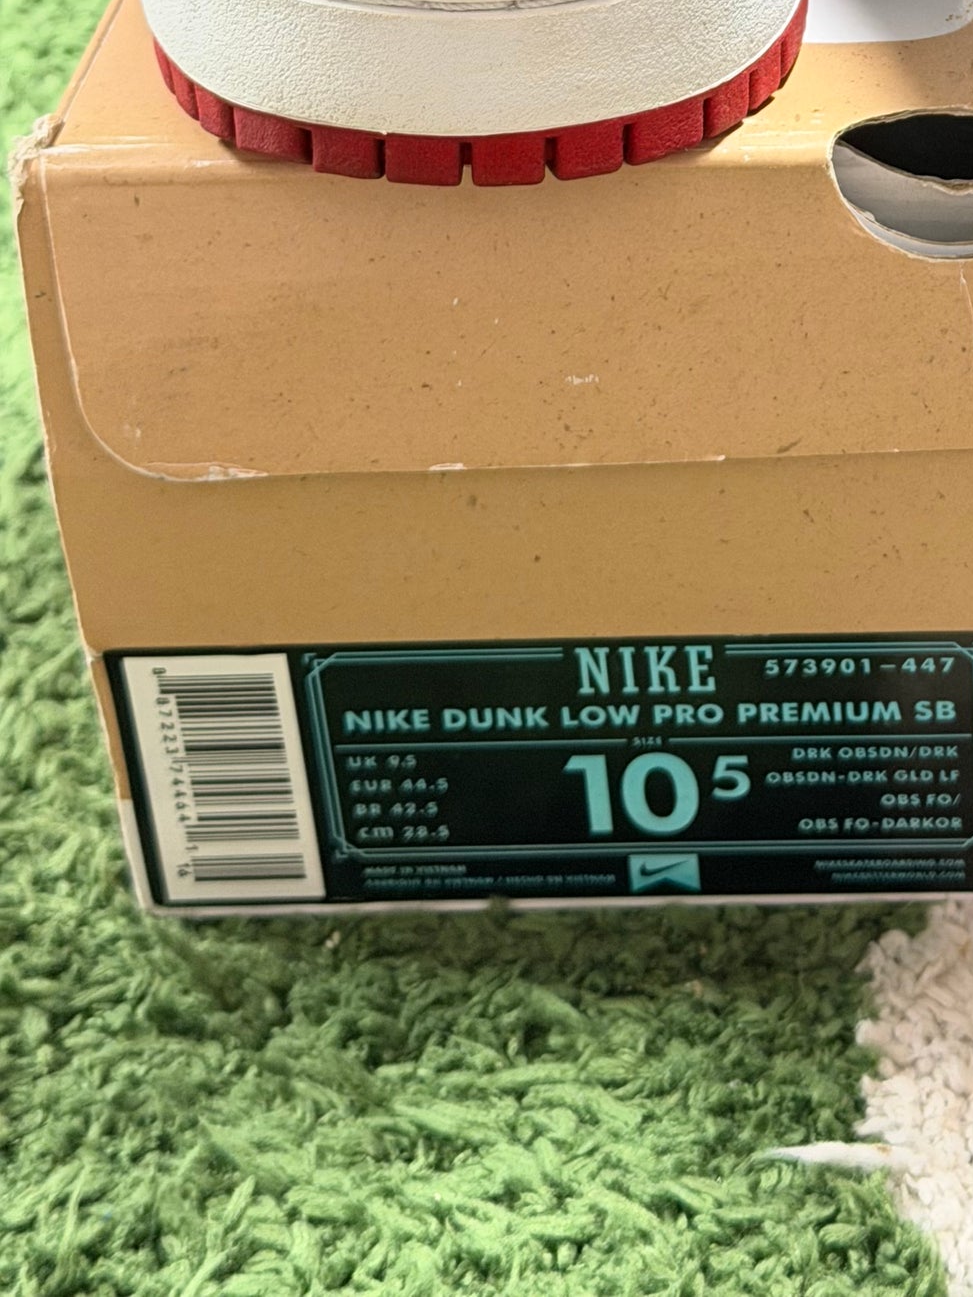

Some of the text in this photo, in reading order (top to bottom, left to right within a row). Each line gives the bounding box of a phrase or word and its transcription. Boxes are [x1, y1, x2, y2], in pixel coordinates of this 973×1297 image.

[574, 644, 717, 695] NIKE
[344, 699, 957, 732] NIKE DUNK LOW PRO PREMIUM SB
[791, 745, 959, 760] DRK OBSDN/DRK
[765, 769, 960, 785] OBSDN-DRK GLD LF
[350, 778, 392, 794] EUR
[880, 793, 921, 808] OBS
[798, 817, 963, 832] OBS FO-DARKOR
